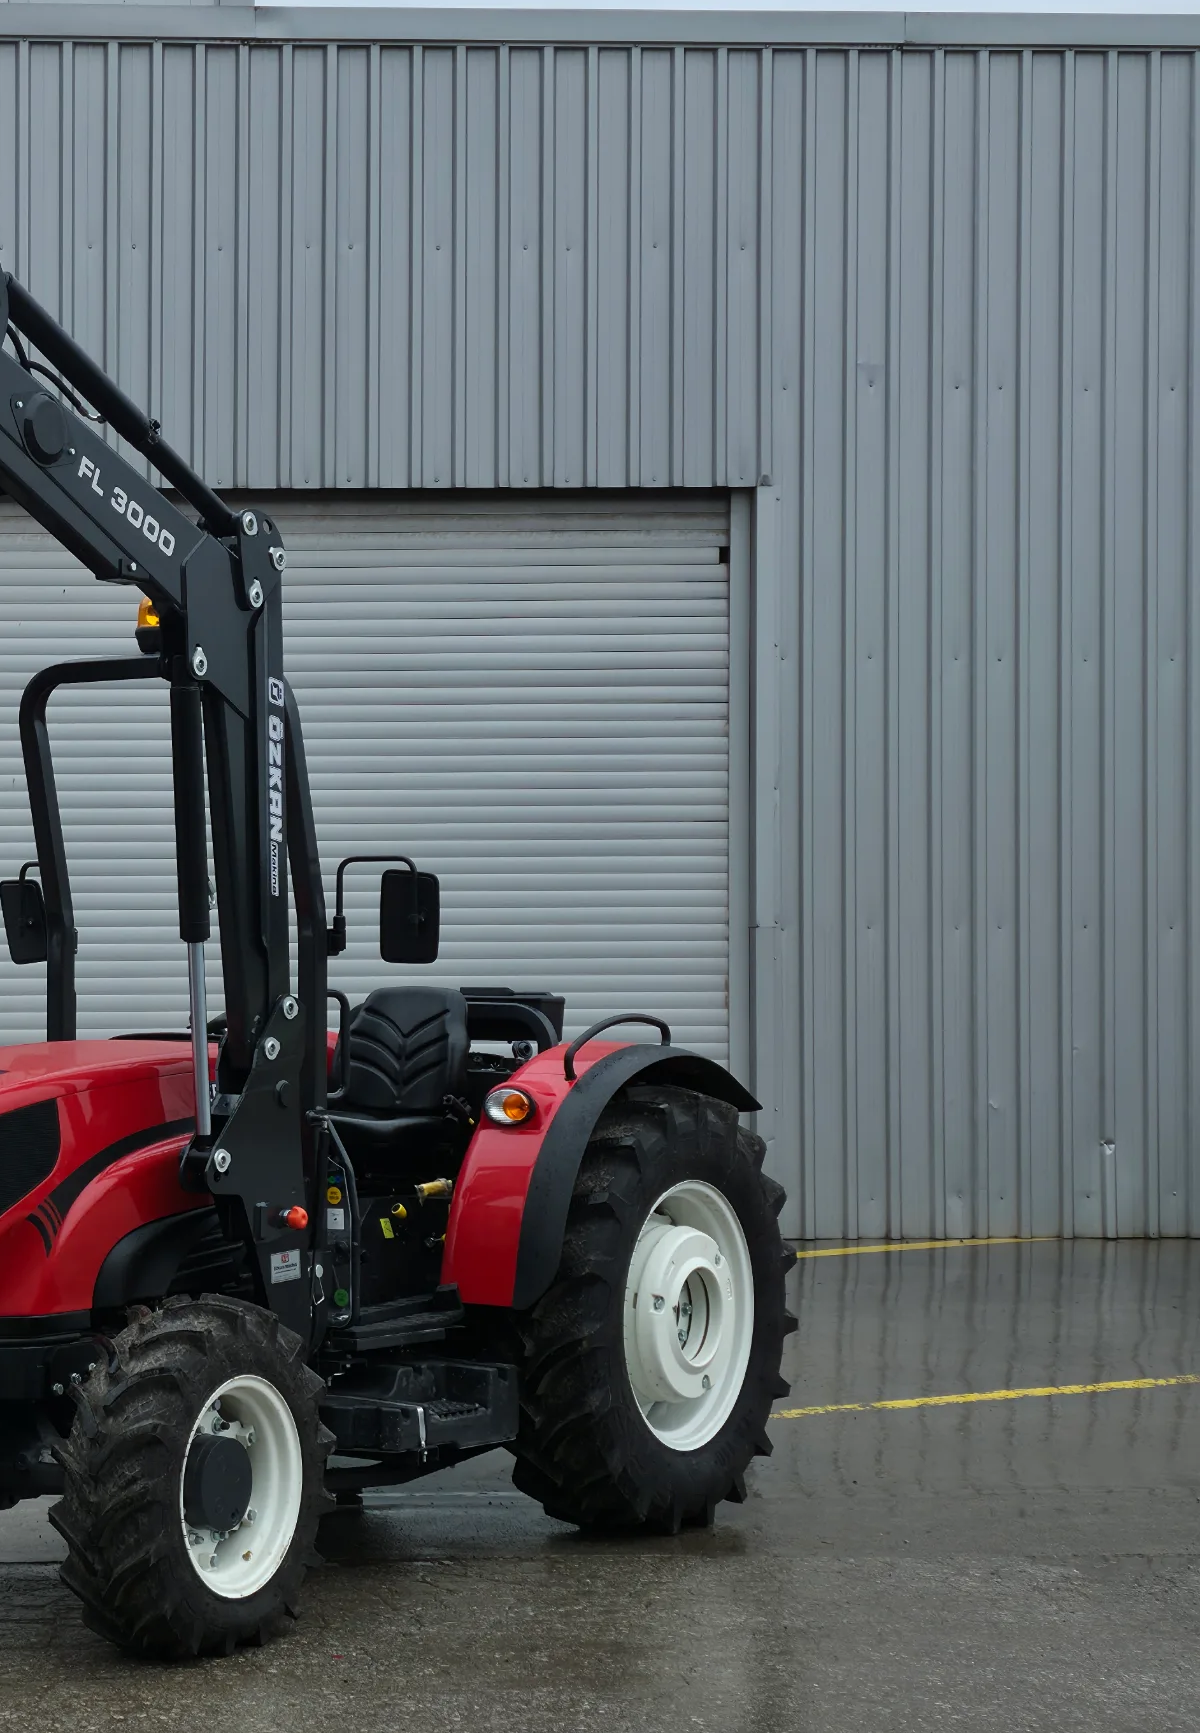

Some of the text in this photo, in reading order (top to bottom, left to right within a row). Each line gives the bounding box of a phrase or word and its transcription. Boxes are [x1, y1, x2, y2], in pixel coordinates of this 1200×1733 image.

[77, 455, 176, 557] FL 3000
[268, 714, 284, 843] ÖZKAN
